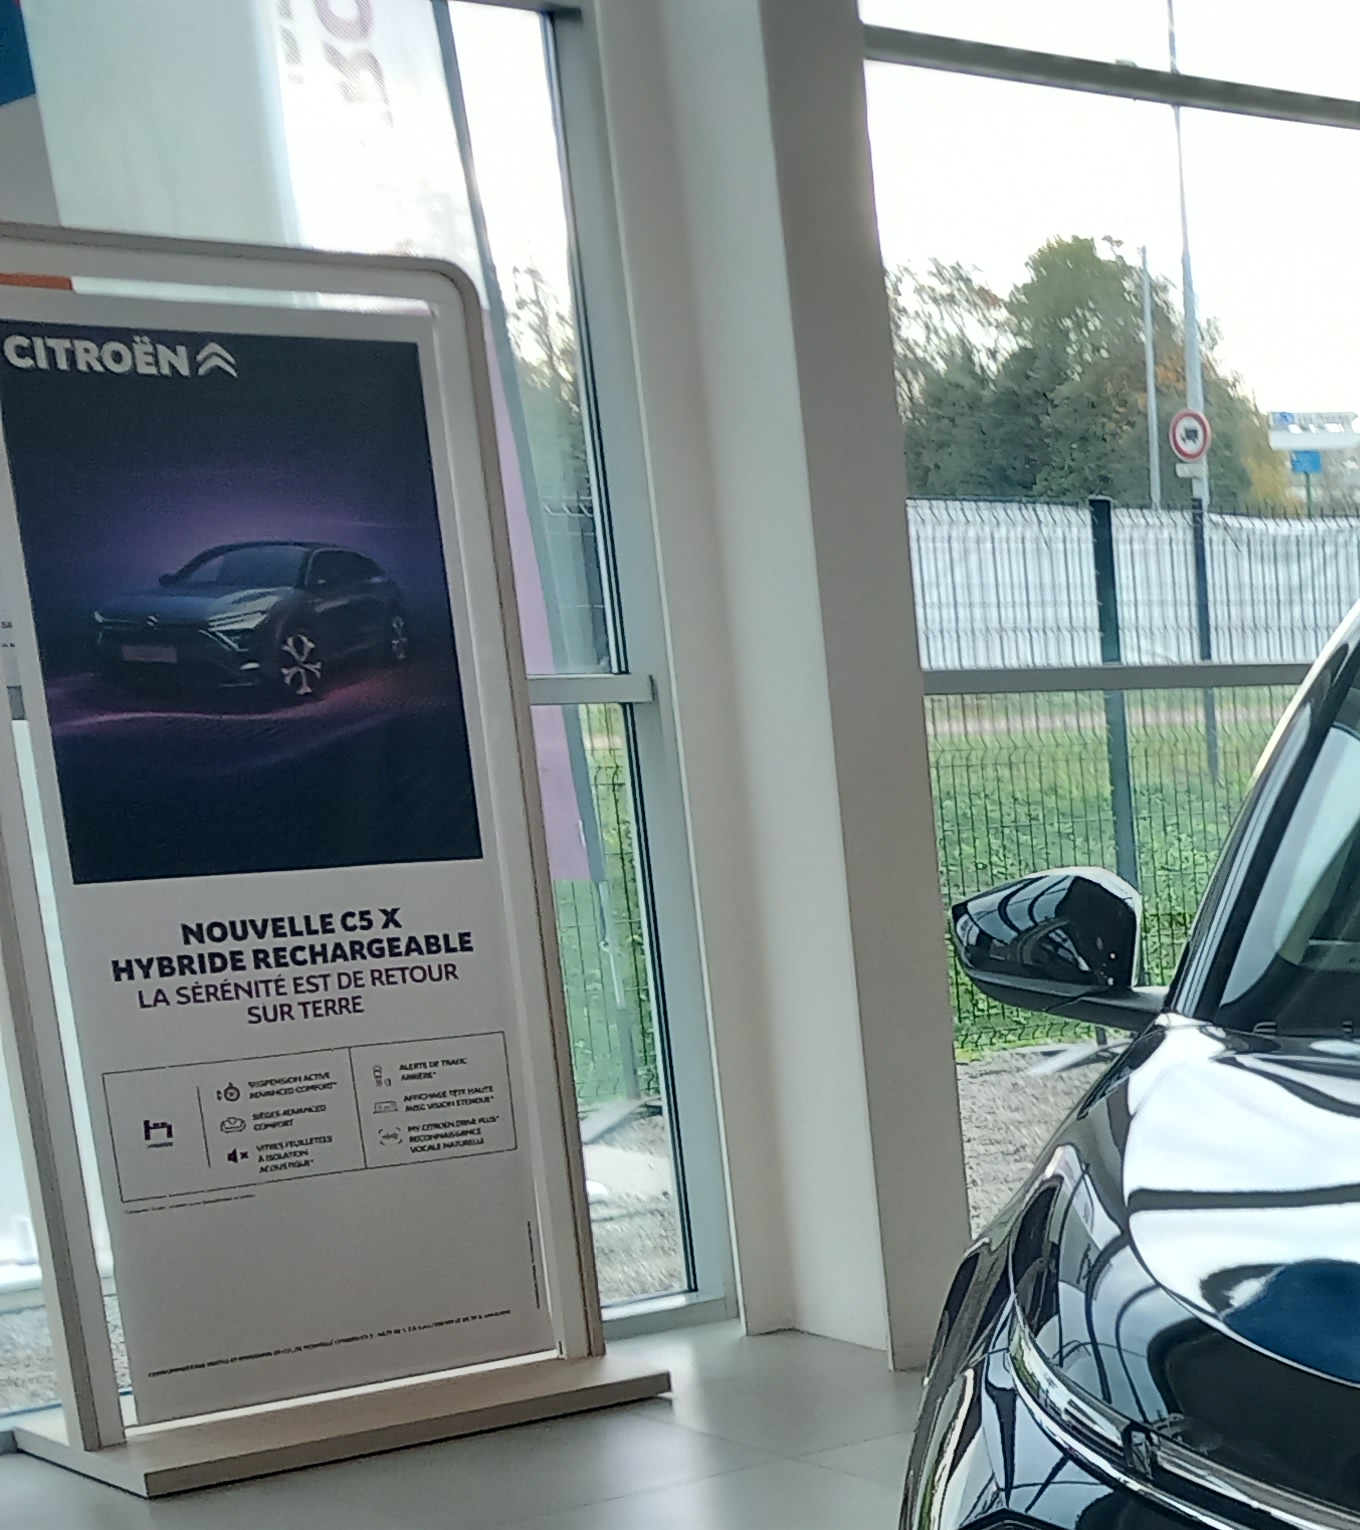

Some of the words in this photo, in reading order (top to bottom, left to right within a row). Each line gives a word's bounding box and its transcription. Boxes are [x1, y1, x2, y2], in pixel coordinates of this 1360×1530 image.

[3, 334, 191, 377] CITROËN
[181, 913, 335, 946] NOUVELLE
[340, 910, 374, 932] C5
[378, 907, 403, 930] X
[111, 950, 247, 982] HYBRIDE
[253, 931, 474, 970] RECHARGEABLE
[138, 988, 171, 1009] LA
[176, 974, 288, 1005] SÉRÉNITÉ
[293, 974, 330, 996] EST
[338, 969, 366, 990] DE
[372, 962, 459, 987] RETOUR
[247, 1004, 295, 1024] SUR
[298, 996, 365, 1018] TERRE
